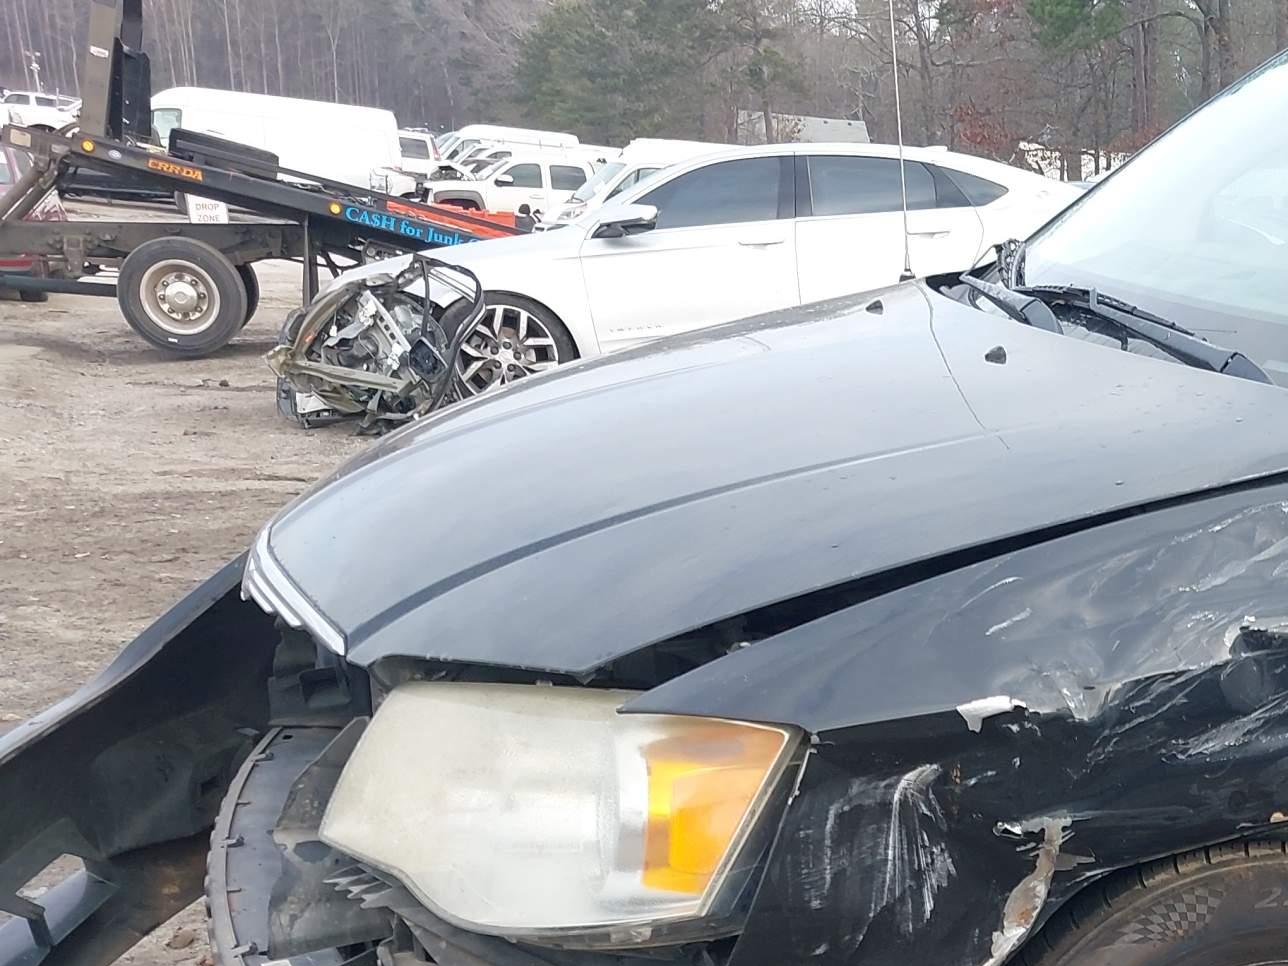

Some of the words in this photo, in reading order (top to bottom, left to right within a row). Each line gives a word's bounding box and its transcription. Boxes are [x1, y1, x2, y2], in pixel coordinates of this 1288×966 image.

[195, 202, 220, 212] DROP
[197, 213, 221, 222] ZONE
[400, 220, 423, 238] for
